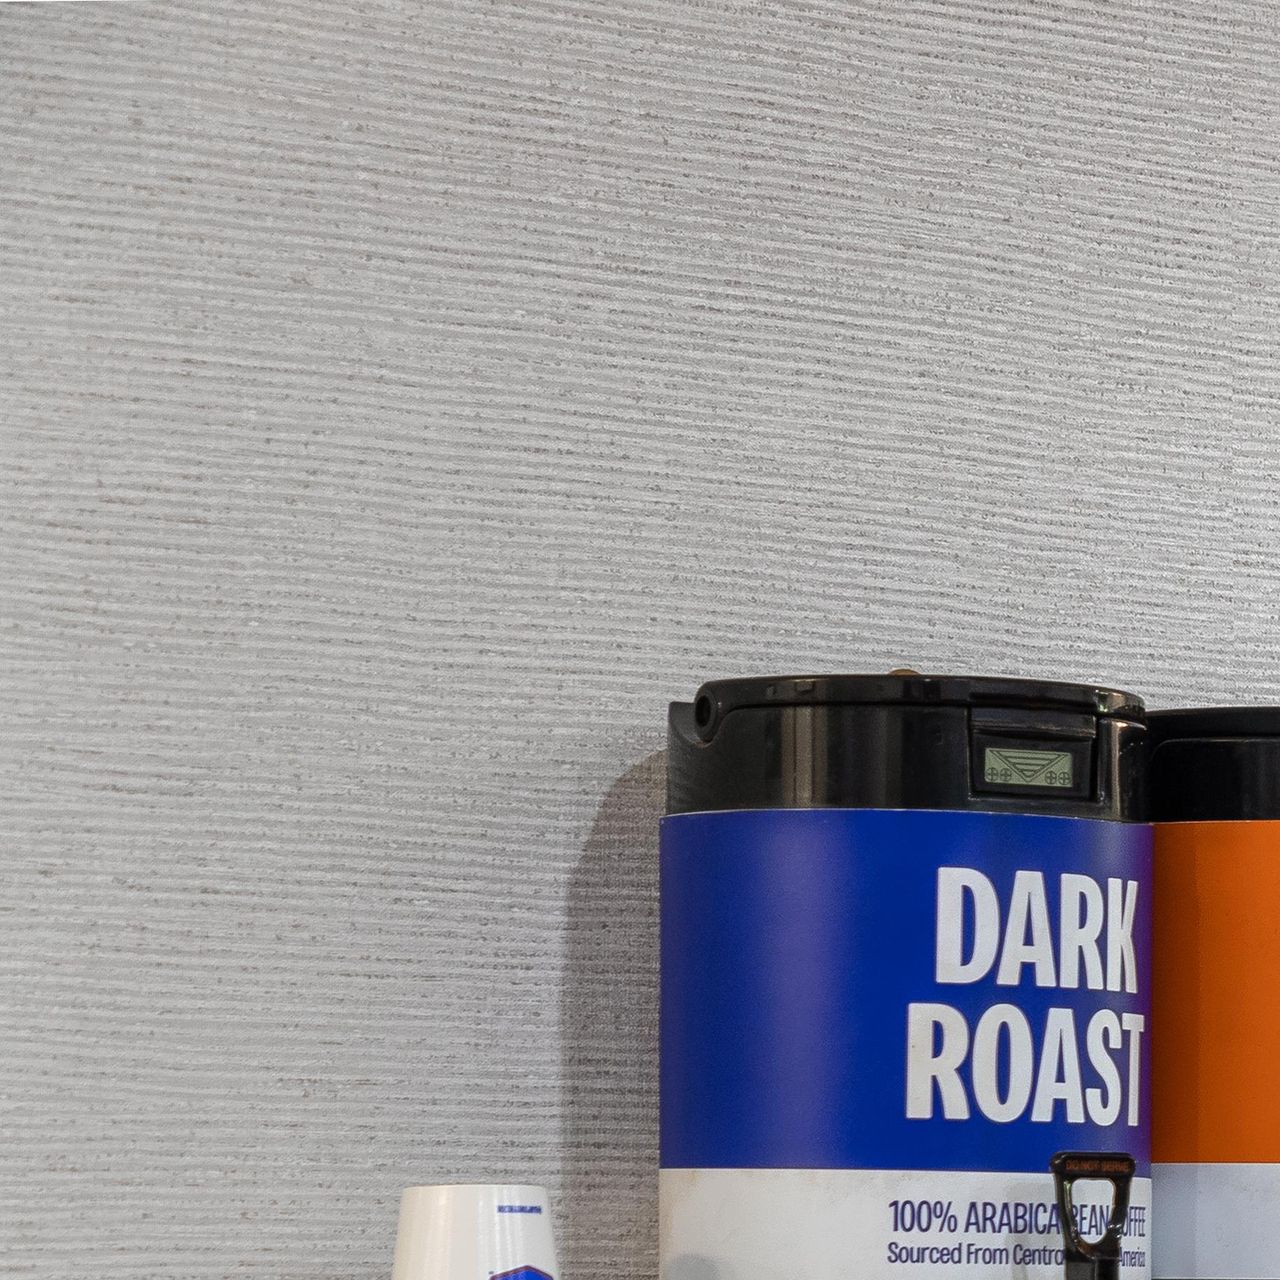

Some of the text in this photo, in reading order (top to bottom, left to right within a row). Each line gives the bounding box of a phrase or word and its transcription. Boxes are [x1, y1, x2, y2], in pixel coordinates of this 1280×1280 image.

[936, 866, 1139, 994] DARK
[905, 1002, 1145, 1126] ROAST
[887, 1242, 962, 1265] Sourced
[966, 1244, 1009, 1266] From
[1013, 1244, 1064, 1266] Centra
[889, 1199, 958, 1233] 100%
[964, 1201, 1060, 1235] ARABICA
[1122, 1205, 1146, 1237] FFEE
